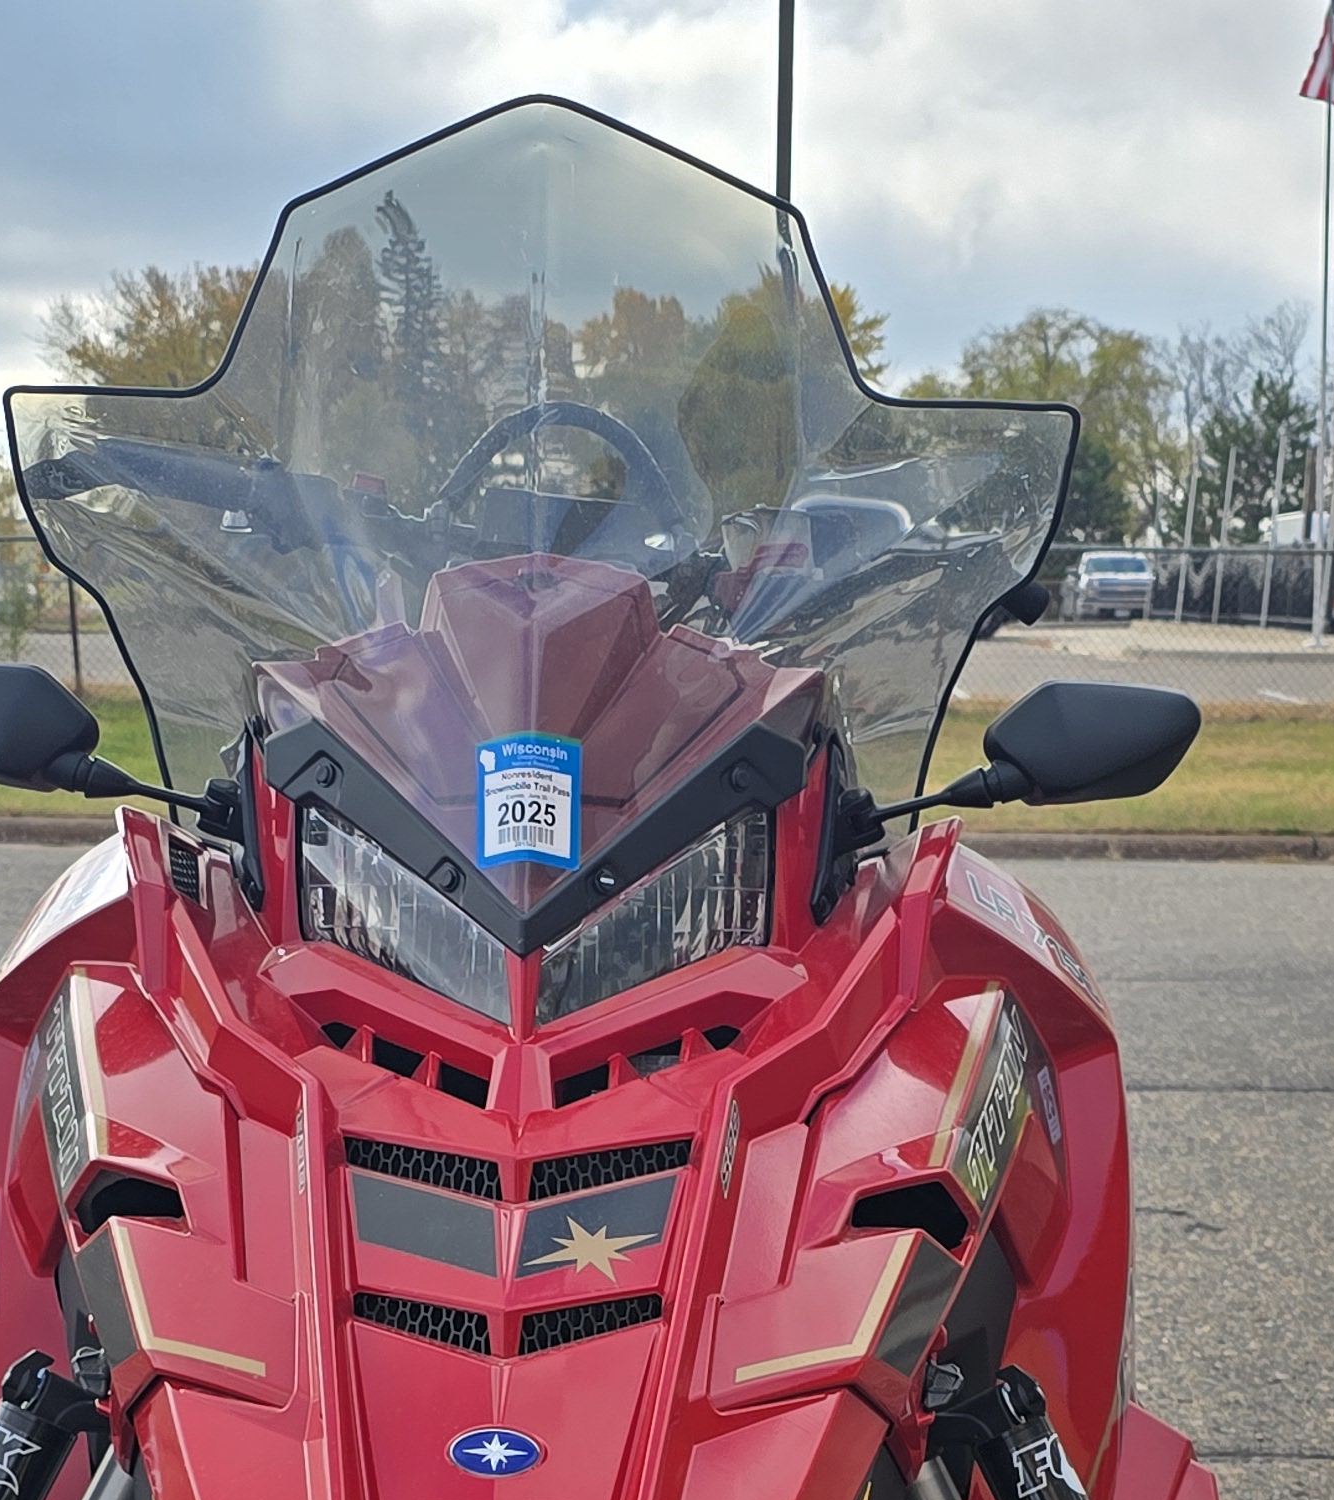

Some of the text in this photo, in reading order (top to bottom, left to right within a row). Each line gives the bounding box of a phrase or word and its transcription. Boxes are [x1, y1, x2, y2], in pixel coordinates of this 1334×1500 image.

[501, 743, 568, 761] Wisconsin
[501, 770, 553, 782] Nonresident
[485, 782, 532, 797] Snowmobile
[533, 782, 551, 793] Trail
[552, 786, 570, 797] Pass
[497, 800, 556, 827] 2025
[46, 995, 78, 1188] TITAN
[967, 1005, 1028, 1200] TITAN
